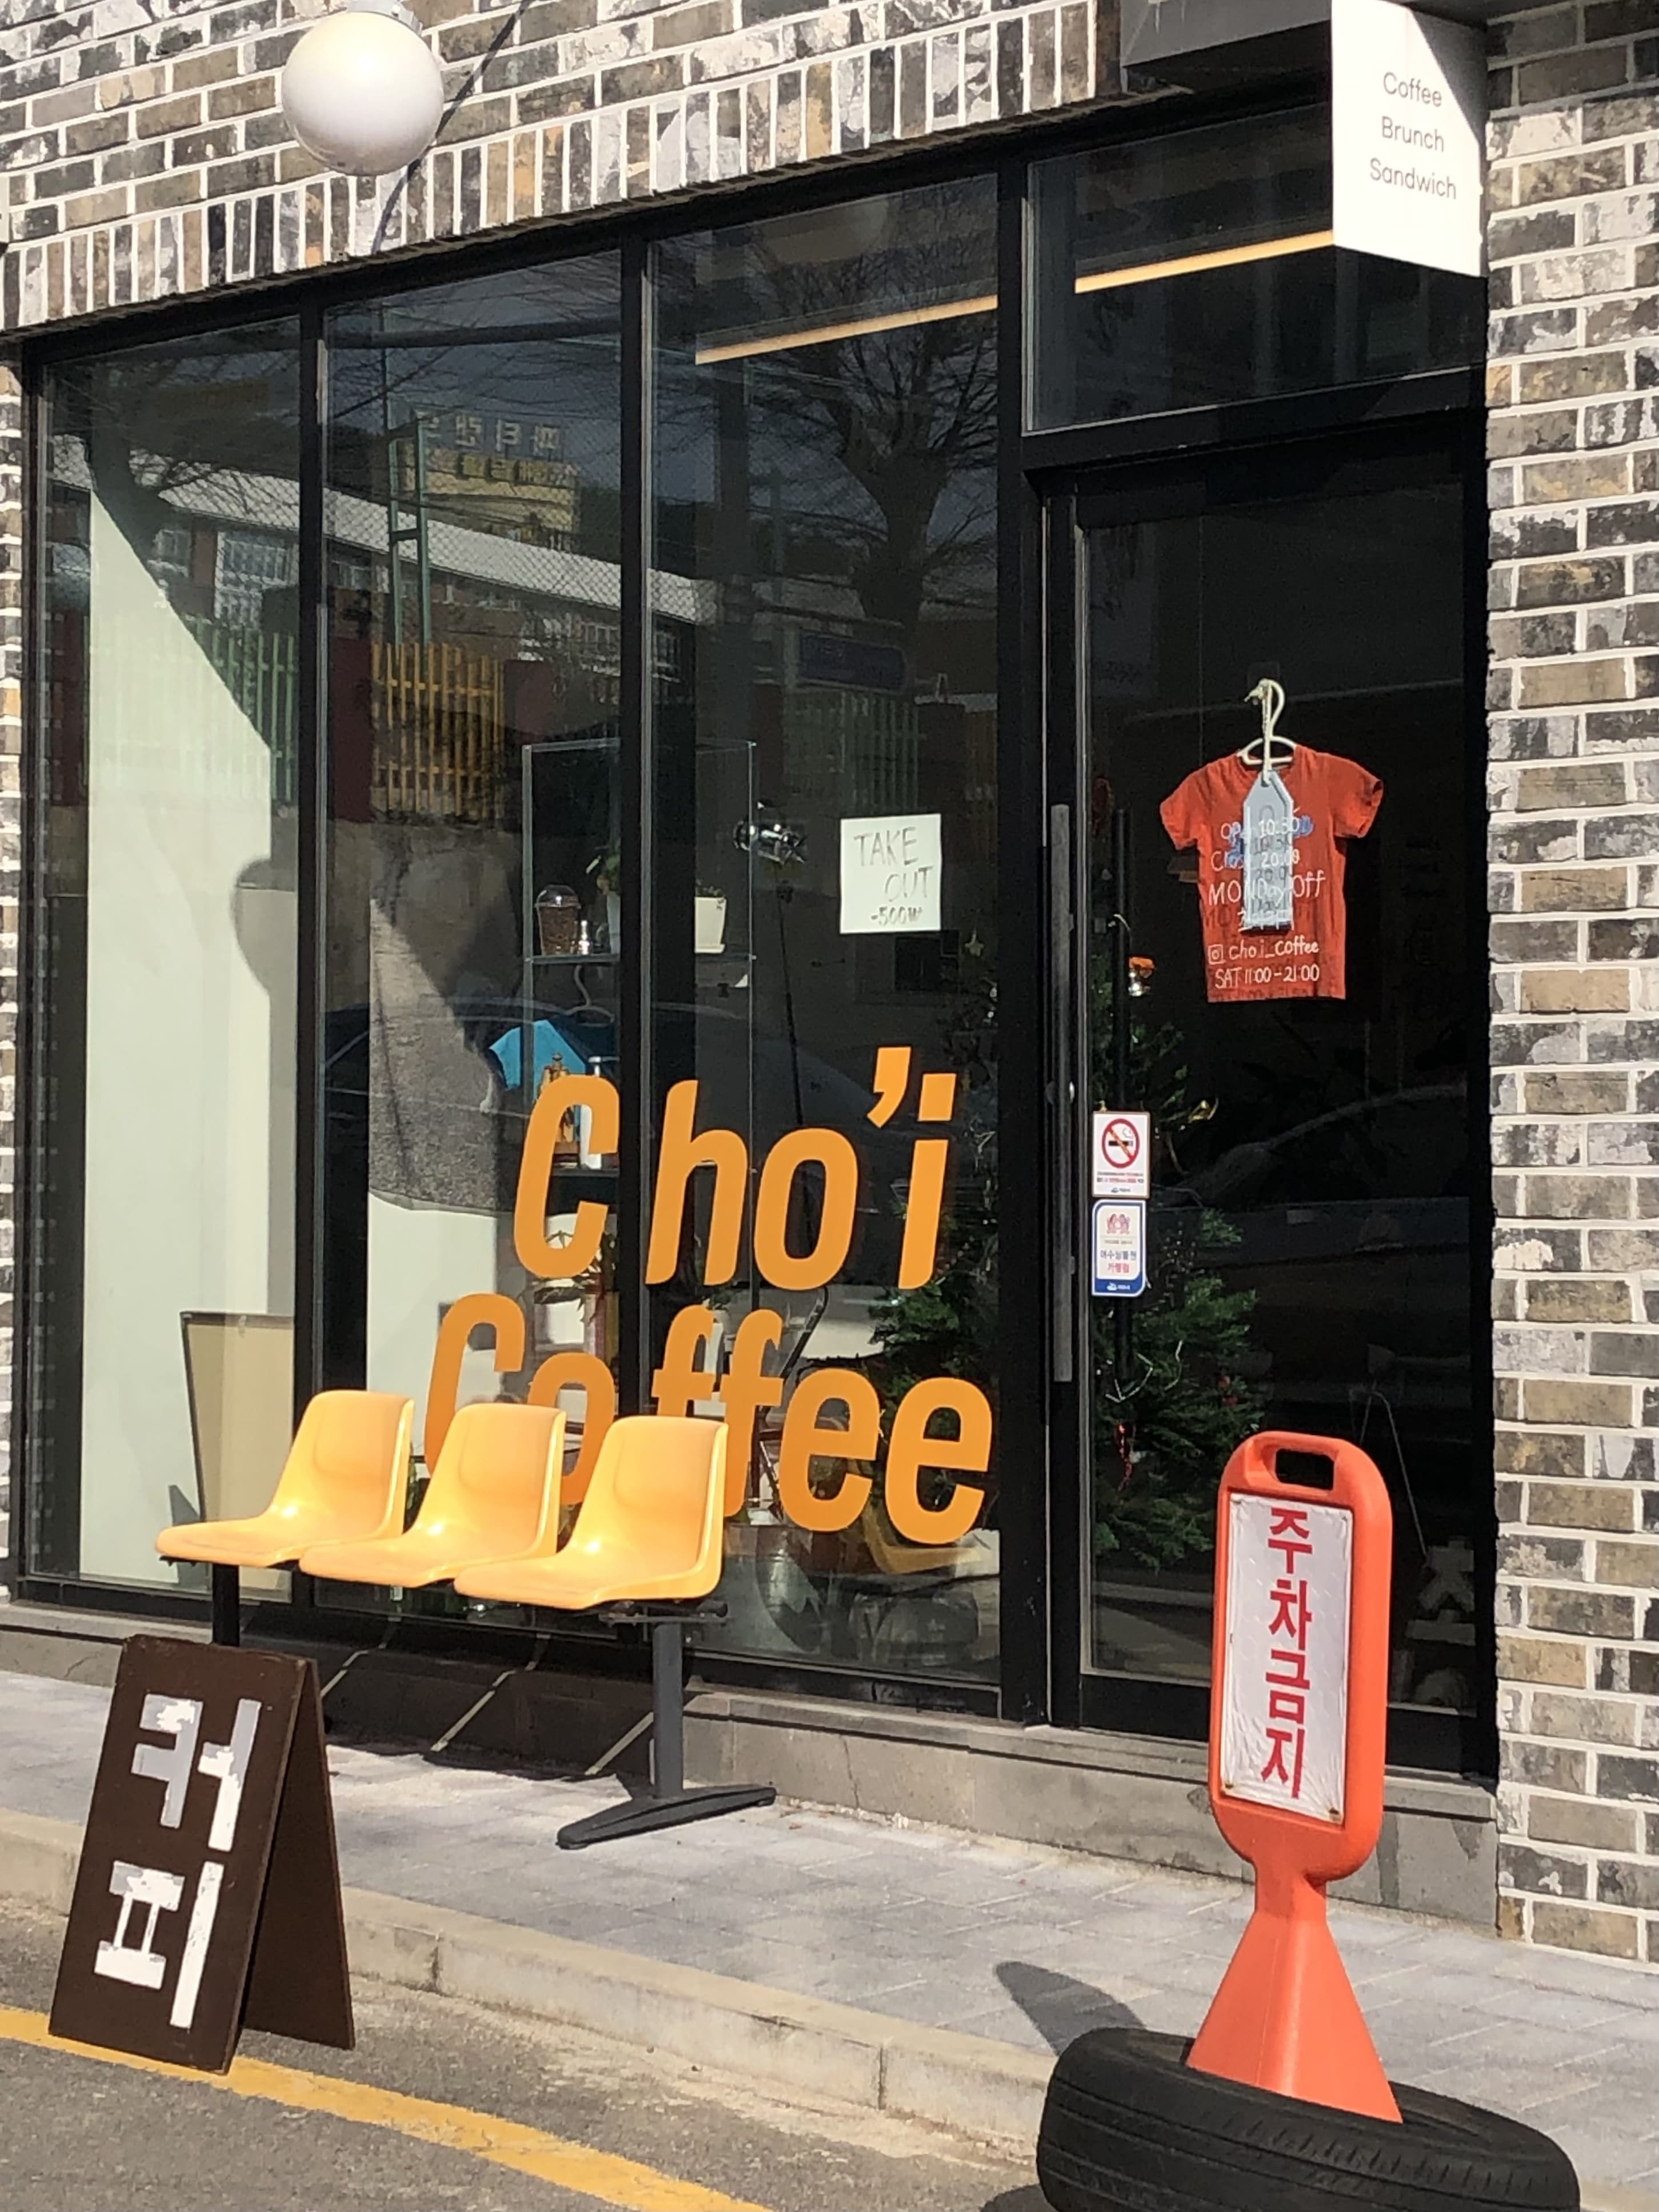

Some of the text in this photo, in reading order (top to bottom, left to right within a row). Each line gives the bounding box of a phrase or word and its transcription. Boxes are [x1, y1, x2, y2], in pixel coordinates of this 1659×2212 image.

[1383, 71, 1442, 107] Coffee
[1381, 115, 1445, 153] Brunch
[1369, 157, 1457, 200] Sandwich
[853, 826, 920, 867] TAKE
[885, 866, 933, 902] OUT
[1214, 966, 1242, 989] SAT
[514, 1046, 956, 1290] Cho'i
[424, 1293, 992, 1545] Coffee
[1261, 1507, 1313, 1799] 주차금지
[93, 1693, 262, 2029] 커피
